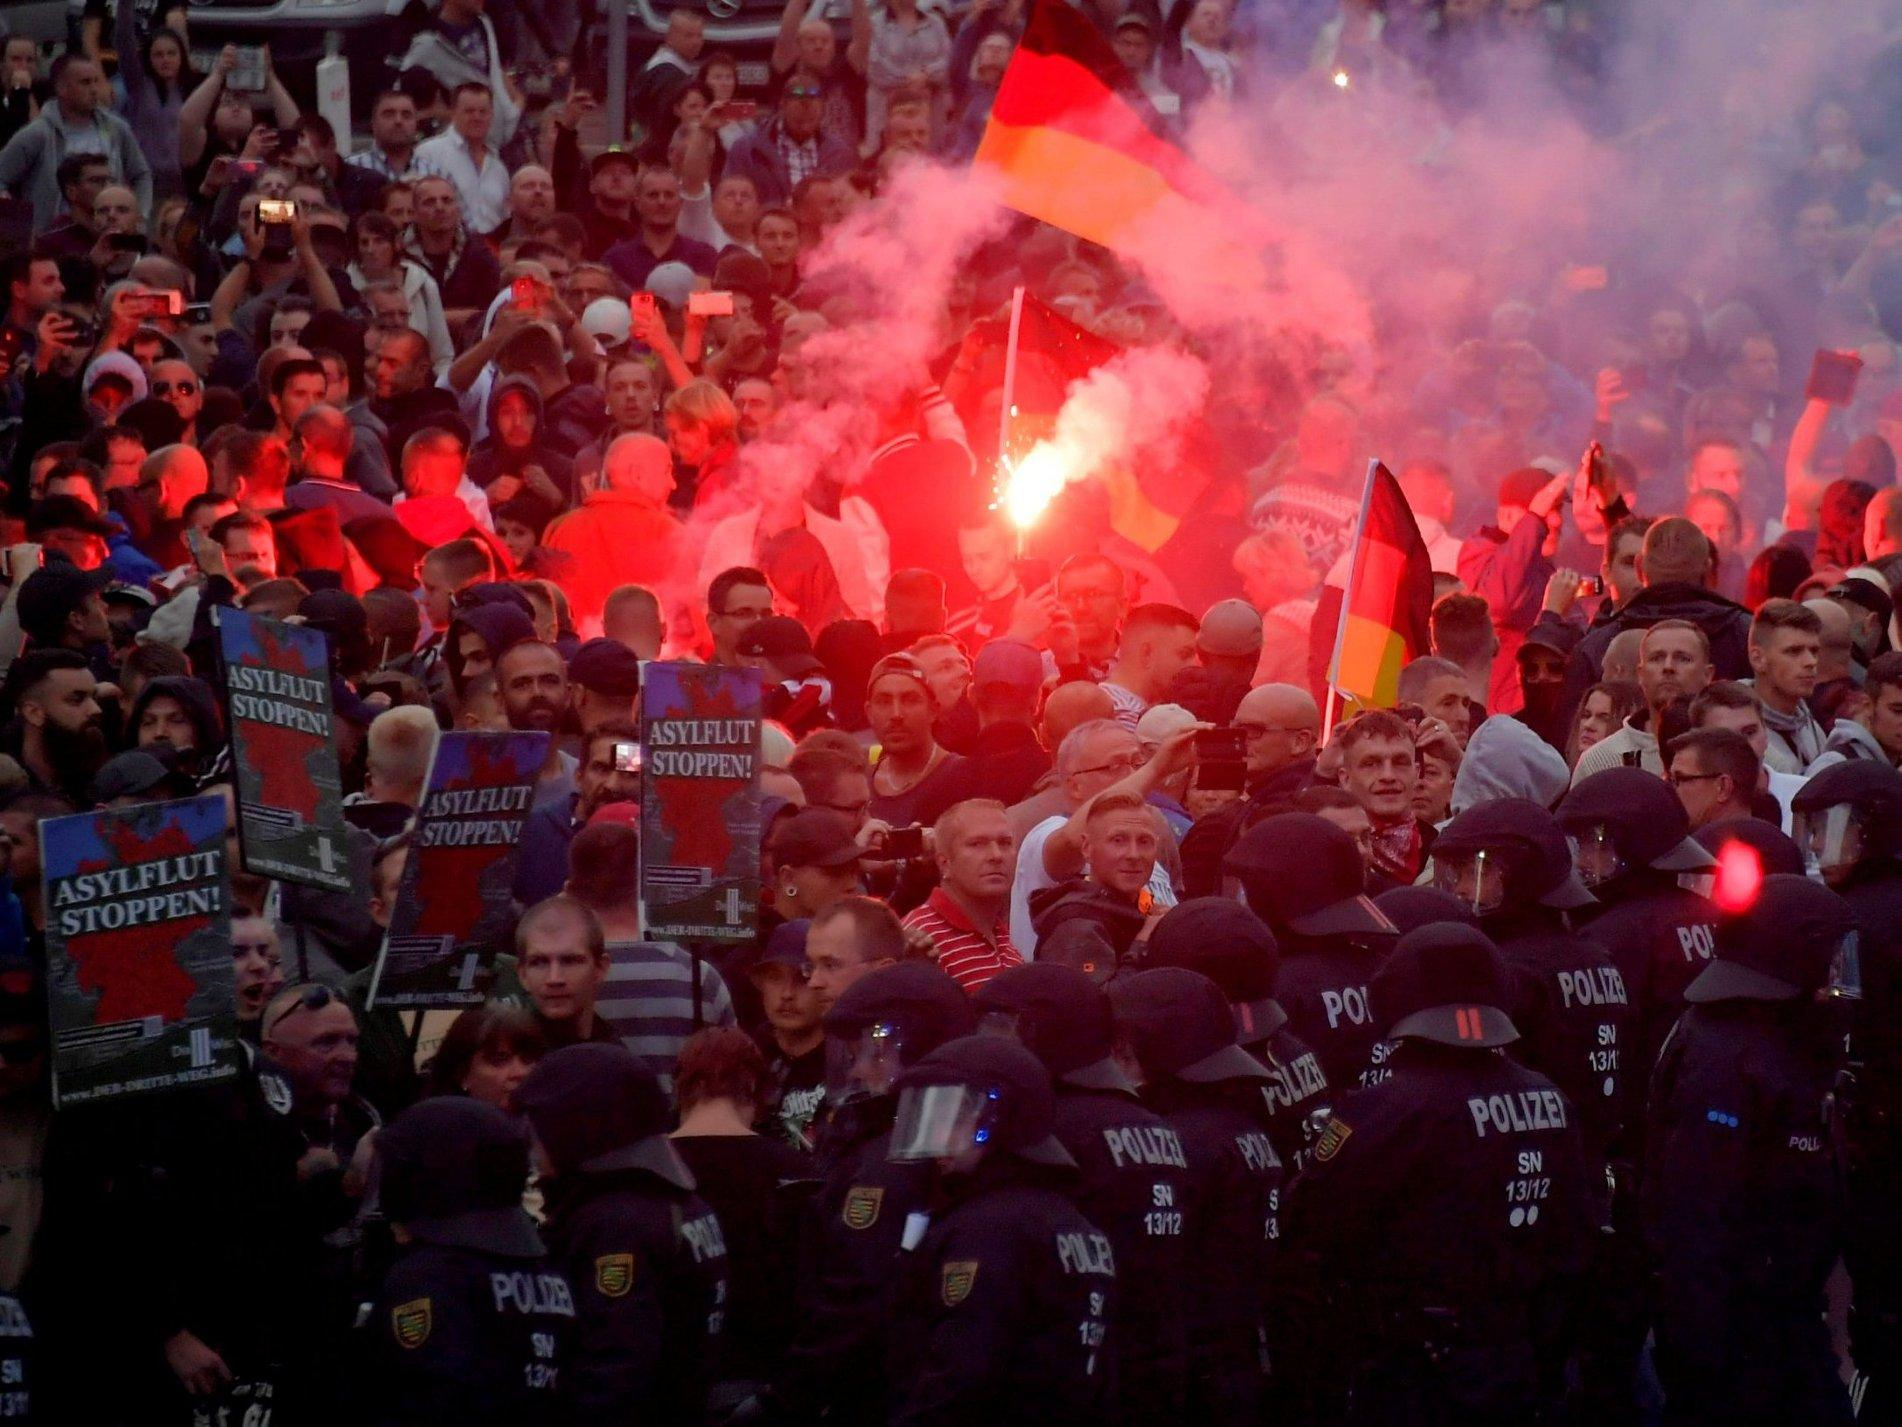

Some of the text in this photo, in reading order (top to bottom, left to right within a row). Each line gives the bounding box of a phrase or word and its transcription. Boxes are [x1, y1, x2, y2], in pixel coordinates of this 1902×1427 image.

[227, 664, 325, 704] ASYLFLUT
[232, 693, 329, 737] STOPPEN!
[649, 721, 755, 745] ASYLFLUT
[652, 752, 752, 778] STOPPEN!
[424, 786, 532, 817] ASYLFLUT
[422, 820, 523, 846] STOPPEN!
[54, 850, 220, 906] ASYLFLUT
[60, 886, 221, 936] STOPPEN!
[1598, 1024, 1616, 1046] SN
[1468, 1091, 1568, 1138] POLIZEI
[1518, 1151, 1542, 1174] SN
[1152, 1184, 1173, 1207] SN
[1506, 1178, 1550, 1202] 13/12
[1144, 1212, 1182, 1236] 13/12
